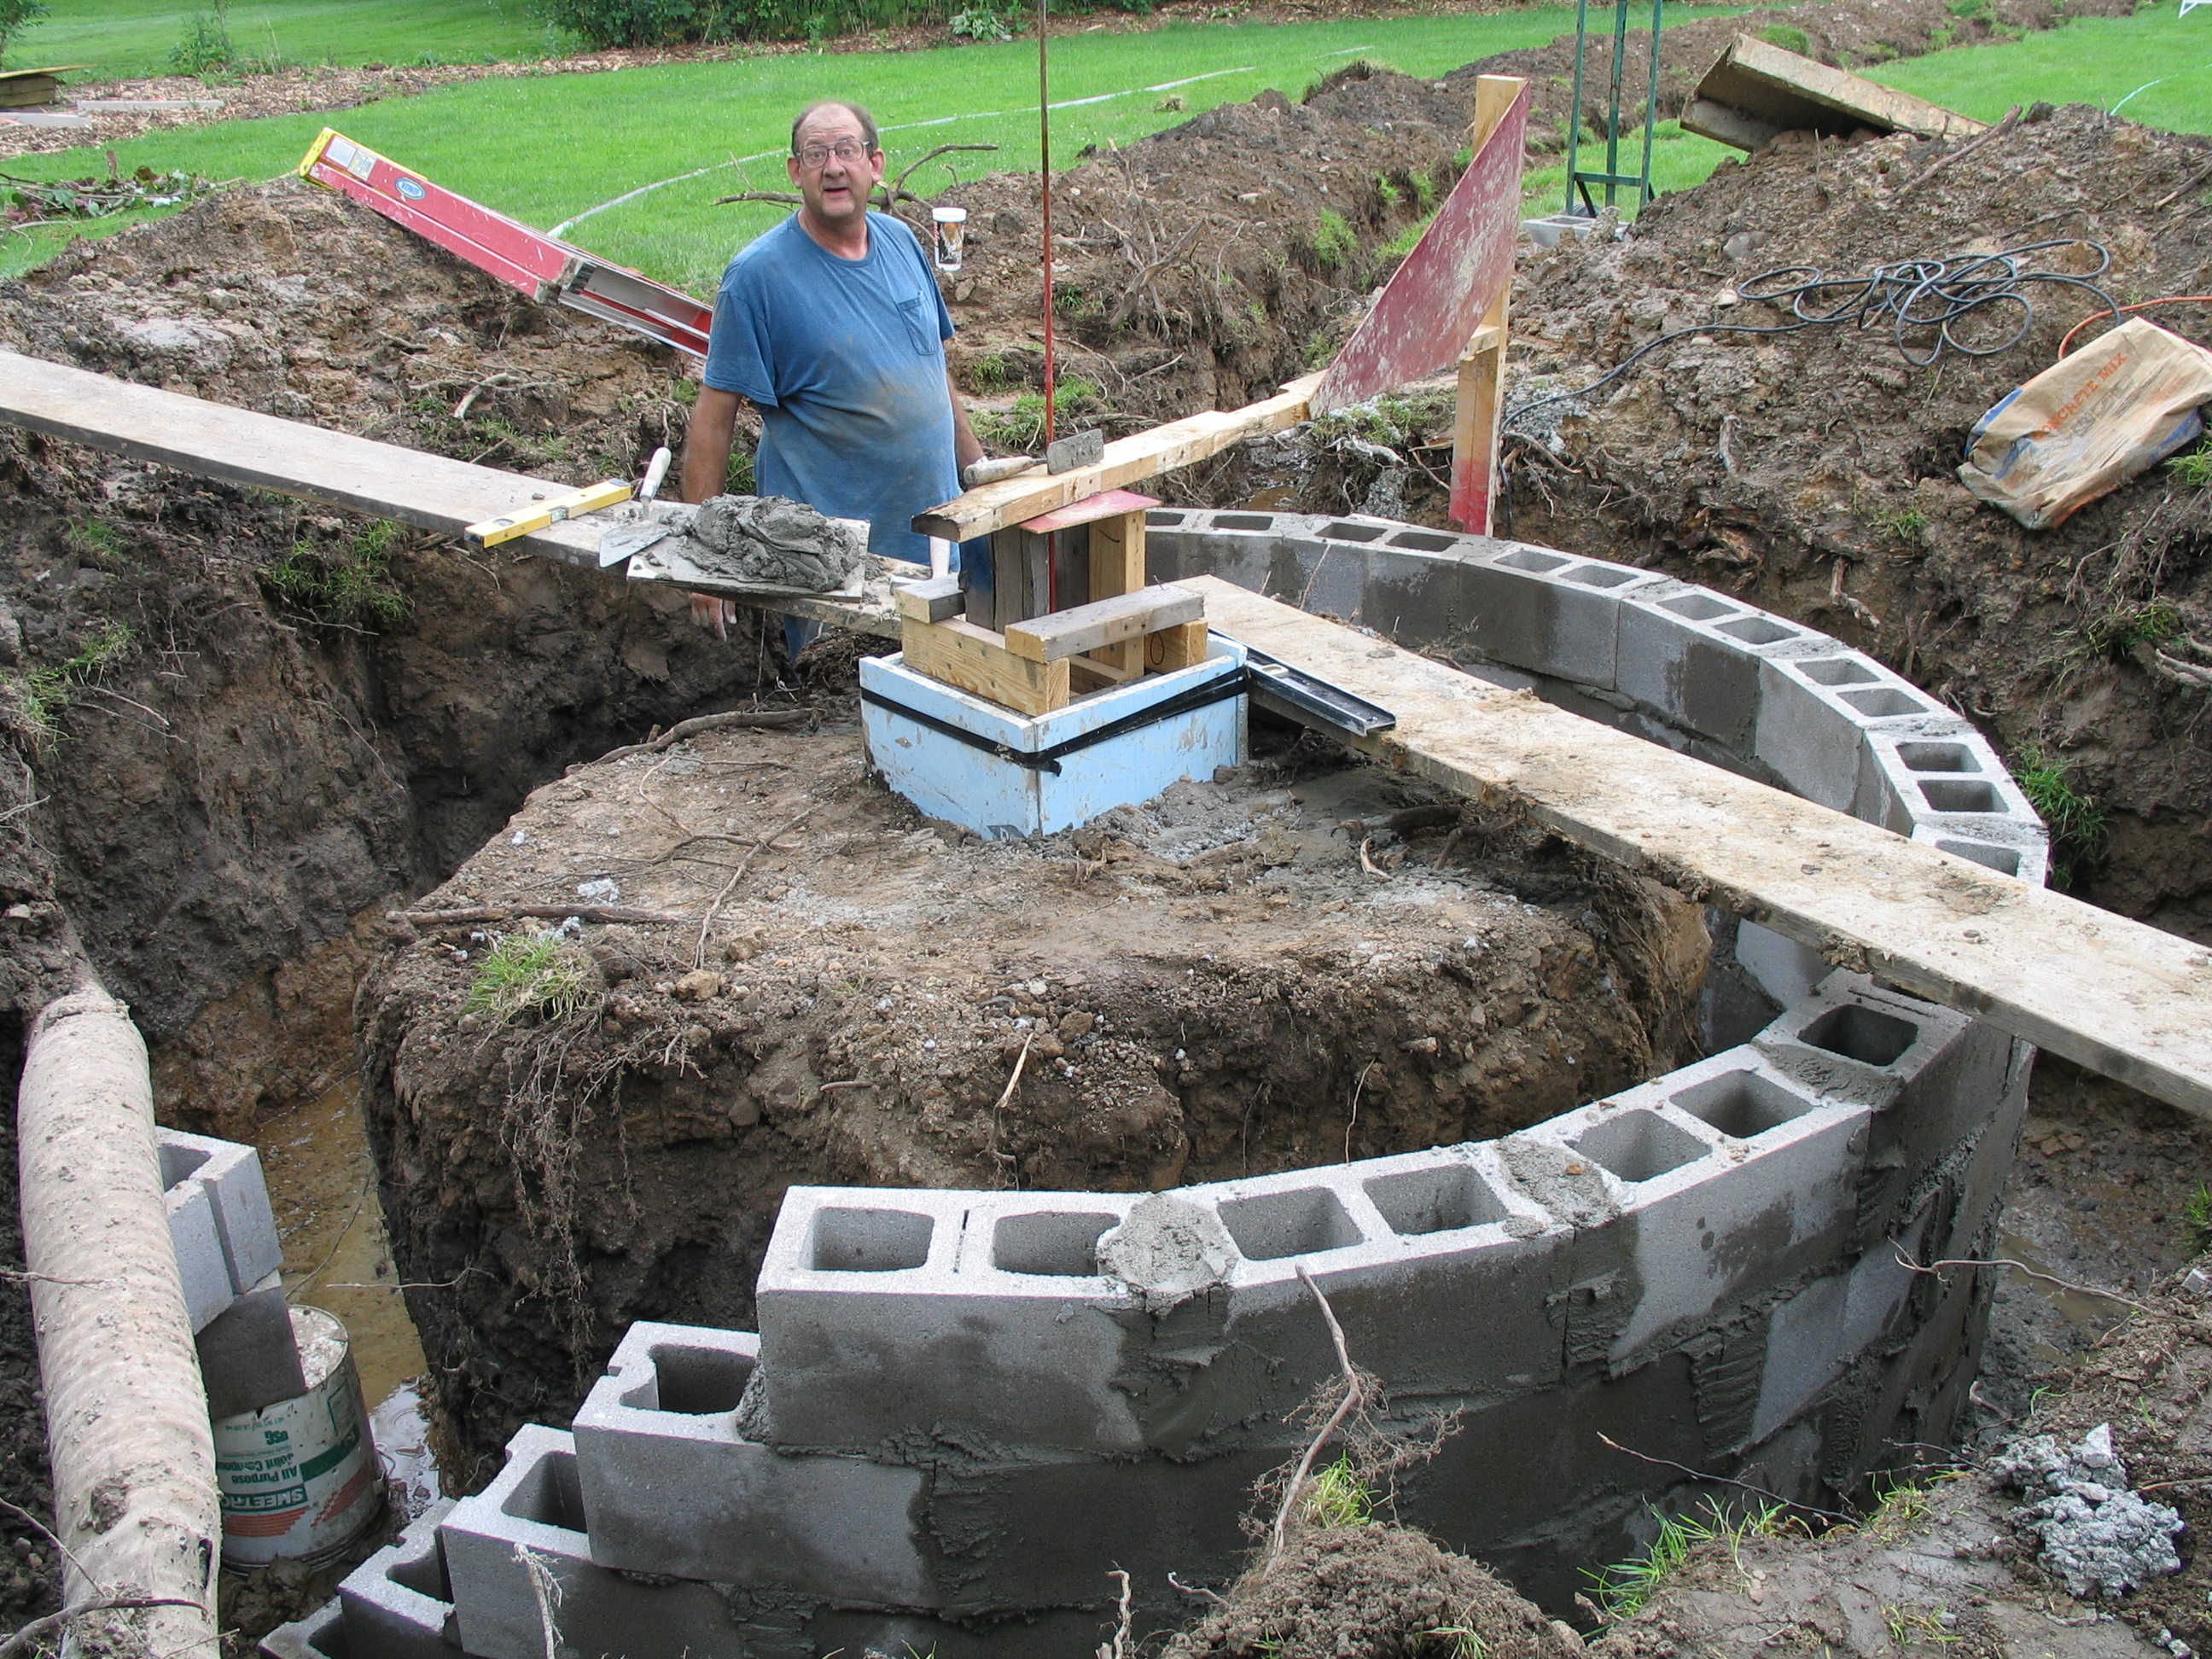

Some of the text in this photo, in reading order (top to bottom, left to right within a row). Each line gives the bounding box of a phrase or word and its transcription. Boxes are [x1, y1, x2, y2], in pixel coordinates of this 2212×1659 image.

[2097, 352, 2128, 381] MIX
[265, 1452, 294, 1470] Joint
[231, 1464, 297, 1484] All Purpose
